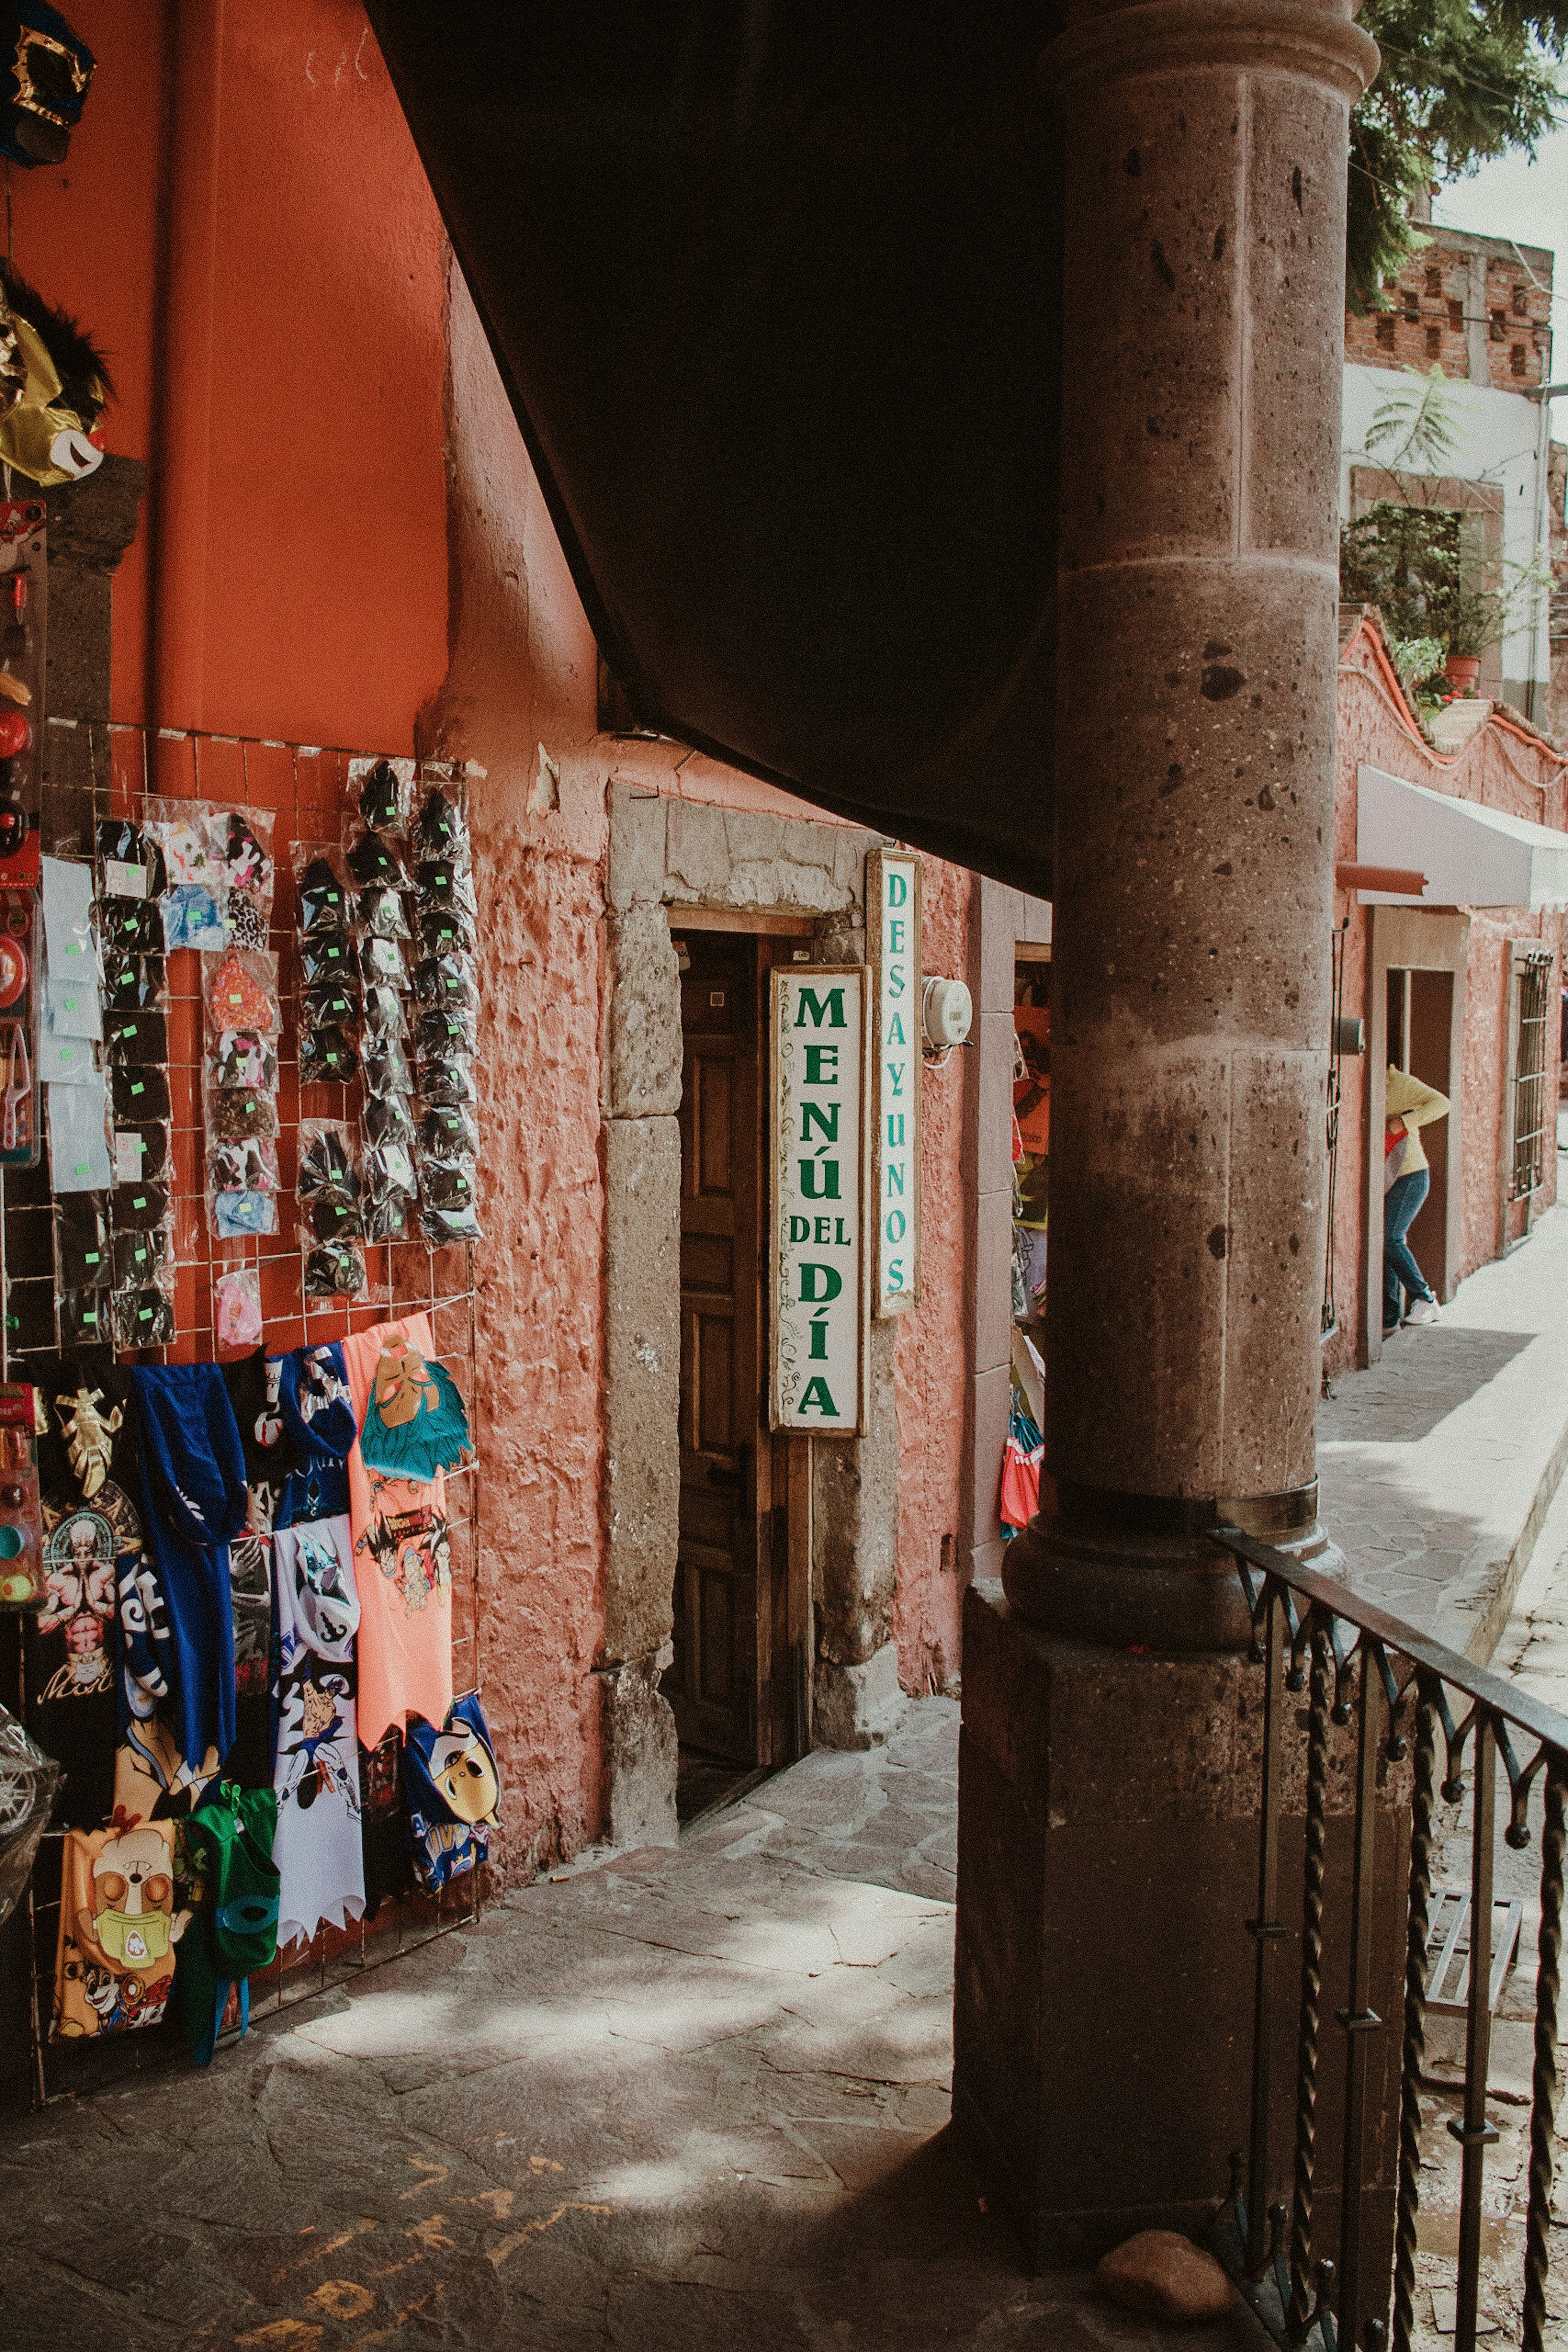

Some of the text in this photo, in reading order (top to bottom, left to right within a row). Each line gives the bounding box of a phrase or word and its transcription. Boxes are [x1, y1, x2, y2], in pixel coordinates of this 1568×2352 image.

[789, 987, 851, 1416] MENÚ DEL DÍA
[886, 874, 907, 1292] DESAYUNOS
